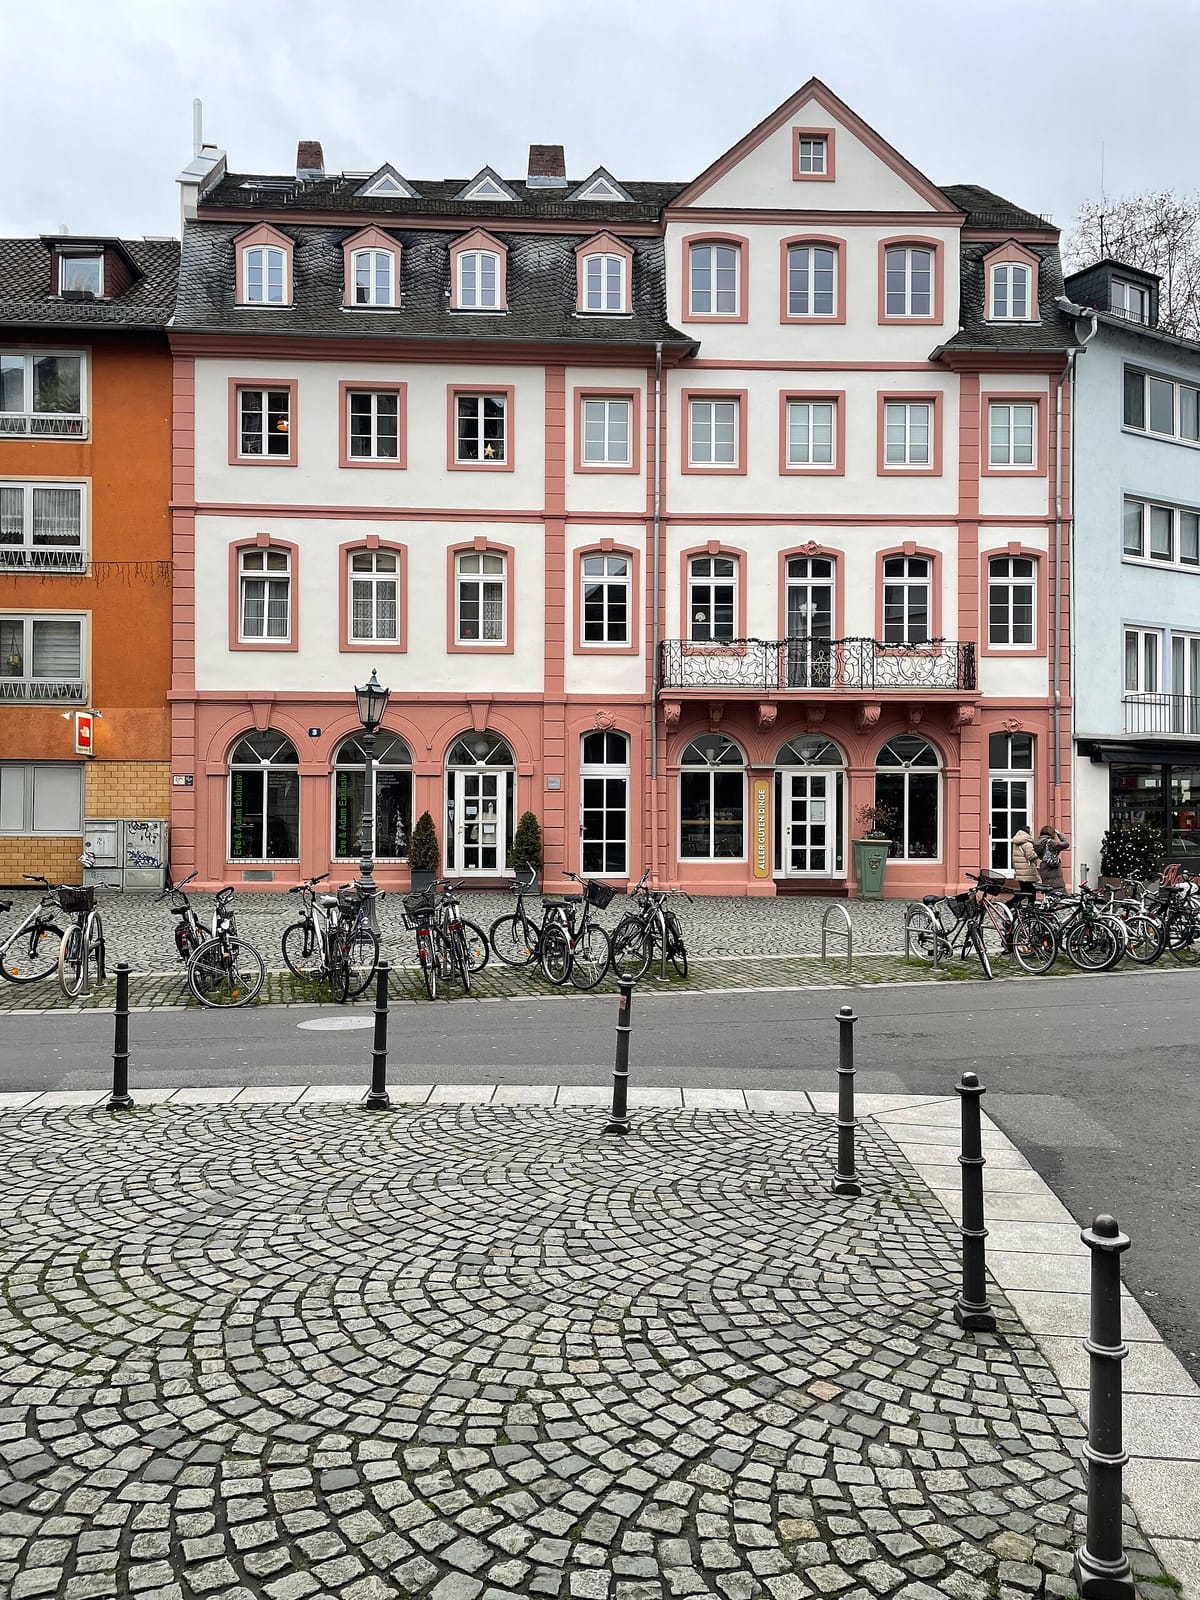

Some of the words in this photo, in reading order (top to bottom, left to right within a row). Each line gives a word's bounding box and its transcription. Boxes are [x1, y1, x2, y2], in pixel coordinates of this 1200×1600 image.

[234, 774, 243, 807] Exklusiv
[339, 774, 348, 807] Exklusiv
[758, 789, 766, 814] DINGE
[234, 808, 243, 831] Adam
[339, 808, 347, 831] Adam
[758, 816, 766, 844] GUTEN
[758, 846, 766, 871] ALLER
